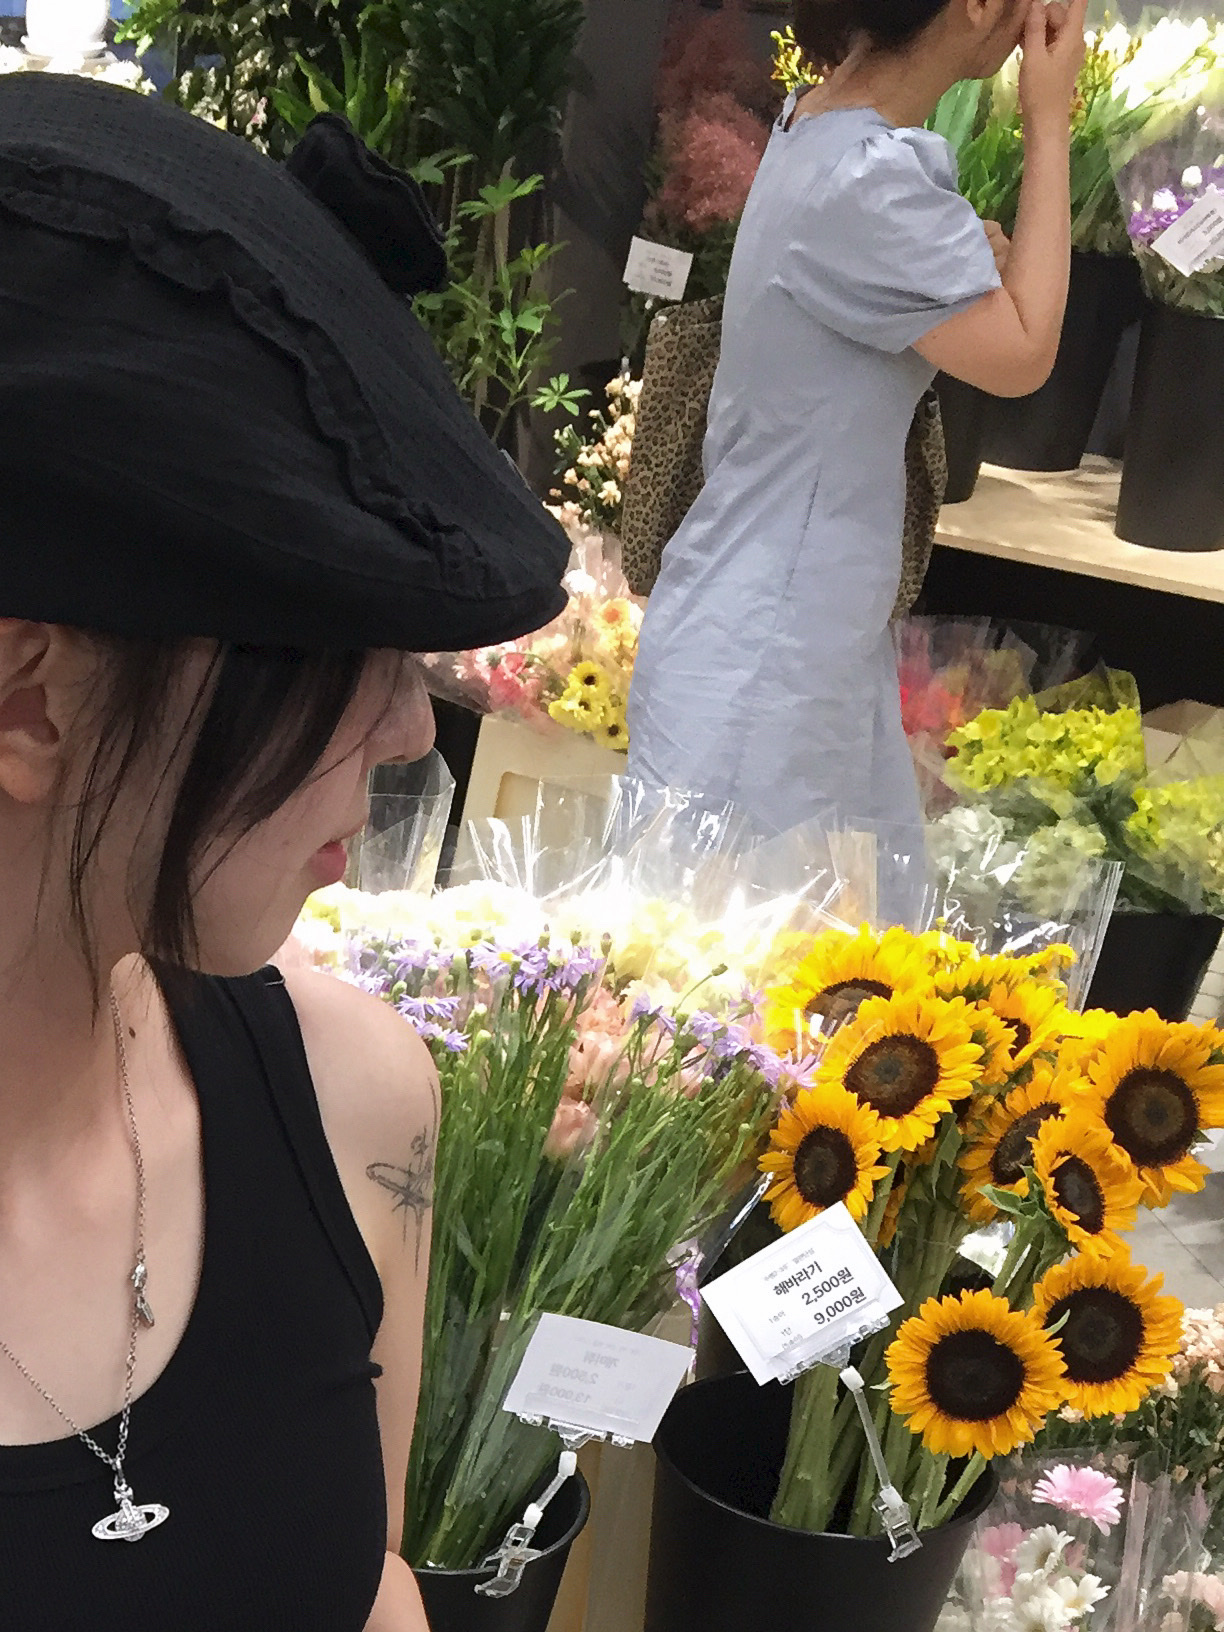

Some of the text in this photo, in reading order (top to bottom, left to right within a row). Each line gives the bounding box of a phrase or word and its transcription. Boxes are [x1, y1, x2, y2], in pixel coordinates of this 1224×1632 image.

[773, 1261, 823, 1296] 해바라기
[802, 1267, 855, 1305] 2,500원
[813, 1287, 867, 1325] 9,000원
